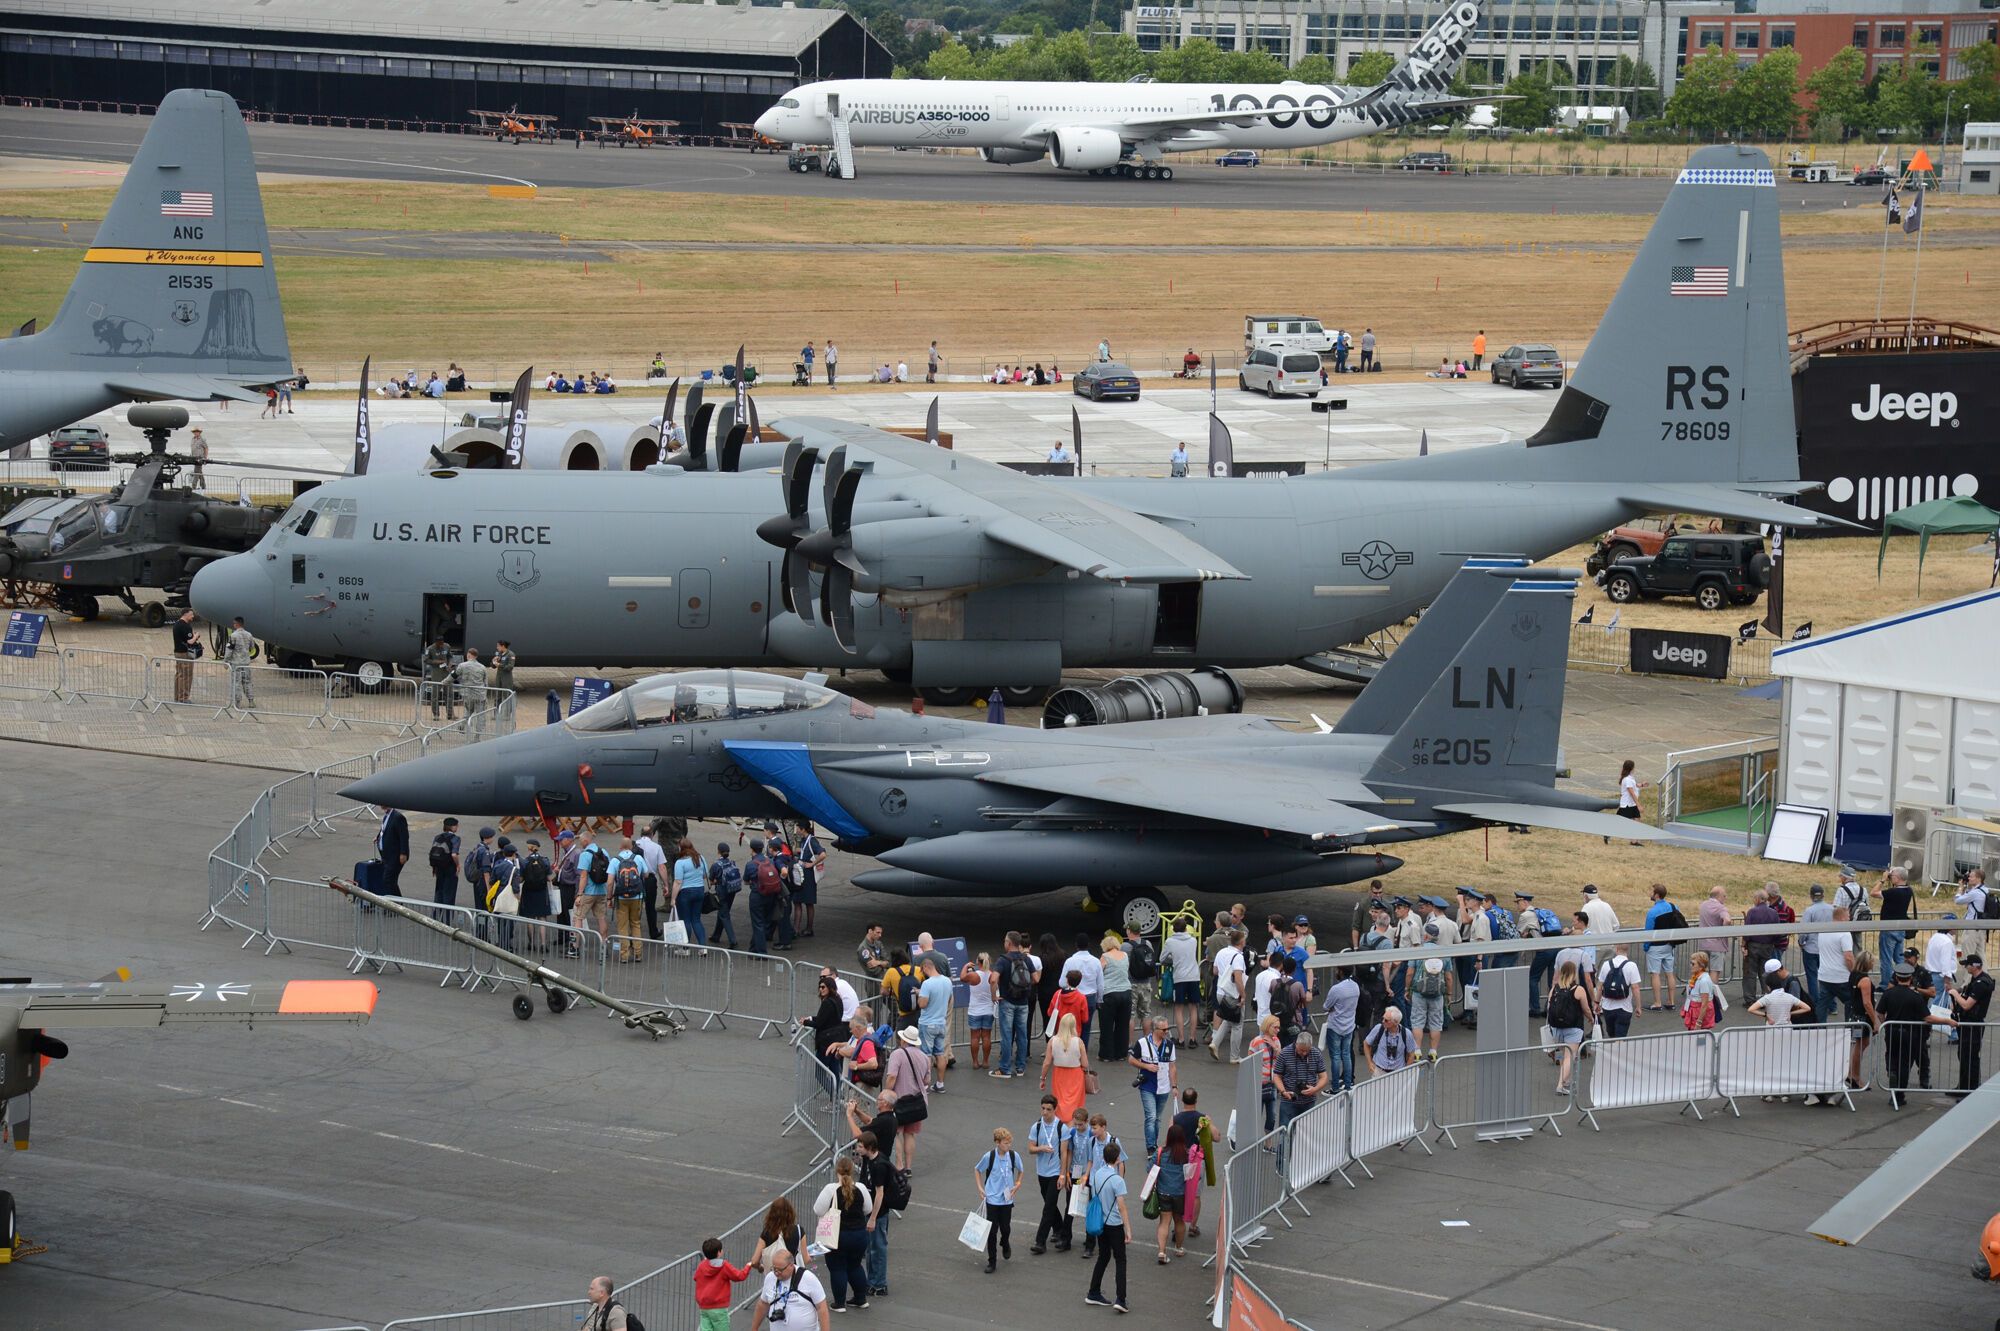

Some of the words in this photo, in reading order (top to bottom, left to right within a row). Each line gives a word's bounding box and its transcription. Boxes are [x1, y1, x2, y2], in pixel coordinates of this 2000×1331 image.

[1409, 2, 1478, 84] A350
[850, 110, 916, 124] AIRBUS
[916, 111, 990, 122] A350-1000
[173, 226, 204, 240] ANG
[156, 250, 216, 263] Wyoming
[168, 275, 213, 289] 21535
[1665, 365, 1730, 410] RS
[1851, 383, 1958, 427] Jeep
[356, 397, 369, 453] Jeep
[1661, 421, 1730, 441] 78609
[506, 408, 527, 465] Jeep
[657, 420, 671, 464] eep
[425, 524, 462, 543] AIR
[473, 525, 551, 545] FORCE
[338, 576, 364, 586] 8609
[338, 592, 351, 601] 86
[355, 592, 369, 601] AW
[1652, 640, 1708, 668] Jeep
[1452, 666, 1515, 709] LN
[1413, 738, 1430, 750] AF
[1433, 738, 1491, 766] 205
[1413, 753, 1429, 766] 96
